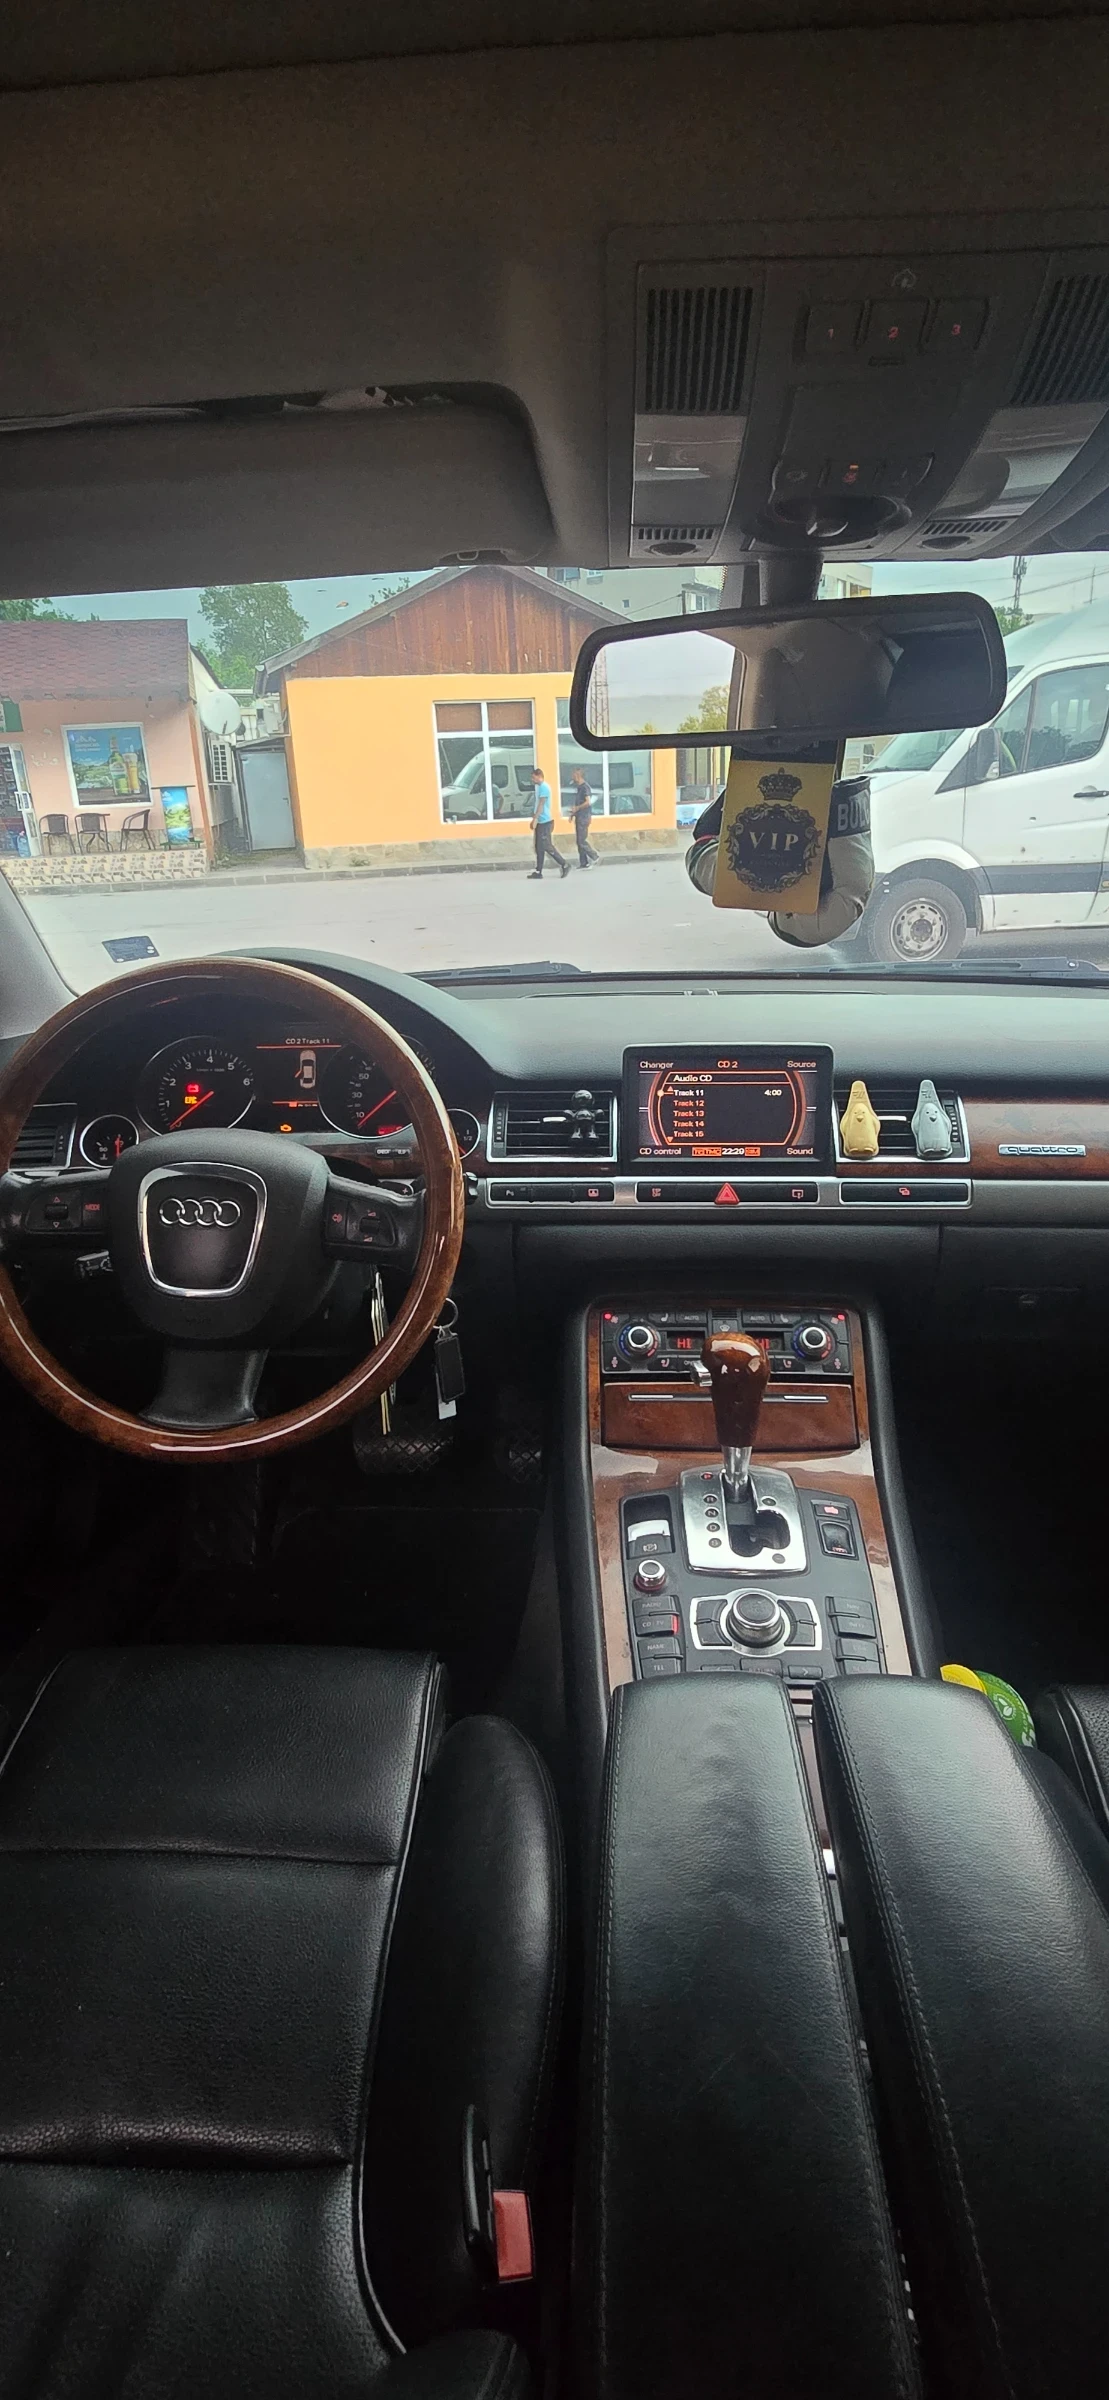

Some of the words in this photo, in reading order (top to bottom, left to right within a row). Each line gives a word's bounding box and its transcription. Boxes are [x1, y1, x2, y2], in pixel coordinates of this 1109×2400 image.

[889, 326, 899, 339] 2
[952, 324, 961, 336] 3
[749, 831, 799, 851] VIP
[185, 1062, 192, 1070] 3
[227, 1062, 235, 1071] 5
[639, 1061, 674, 1069] Changer
[717, 1061, 730, 1069] CD
[169, 1078, 176, 1086] 2
[243, 1078, 251, 1086] 6
[673, 1074, 699, 1082] Audio
[699, 1074, 713, 1082] CD
[351, 1091, 363, 1099] 30
[673, 1089, 694, 1097] Track
[695, 1089, 705, 1097] 11
[787, 1147, 813, 1155] Sound
[1007, 1146, 1078, 1156] quattro
[677, 1337, 692, 1349] HI
